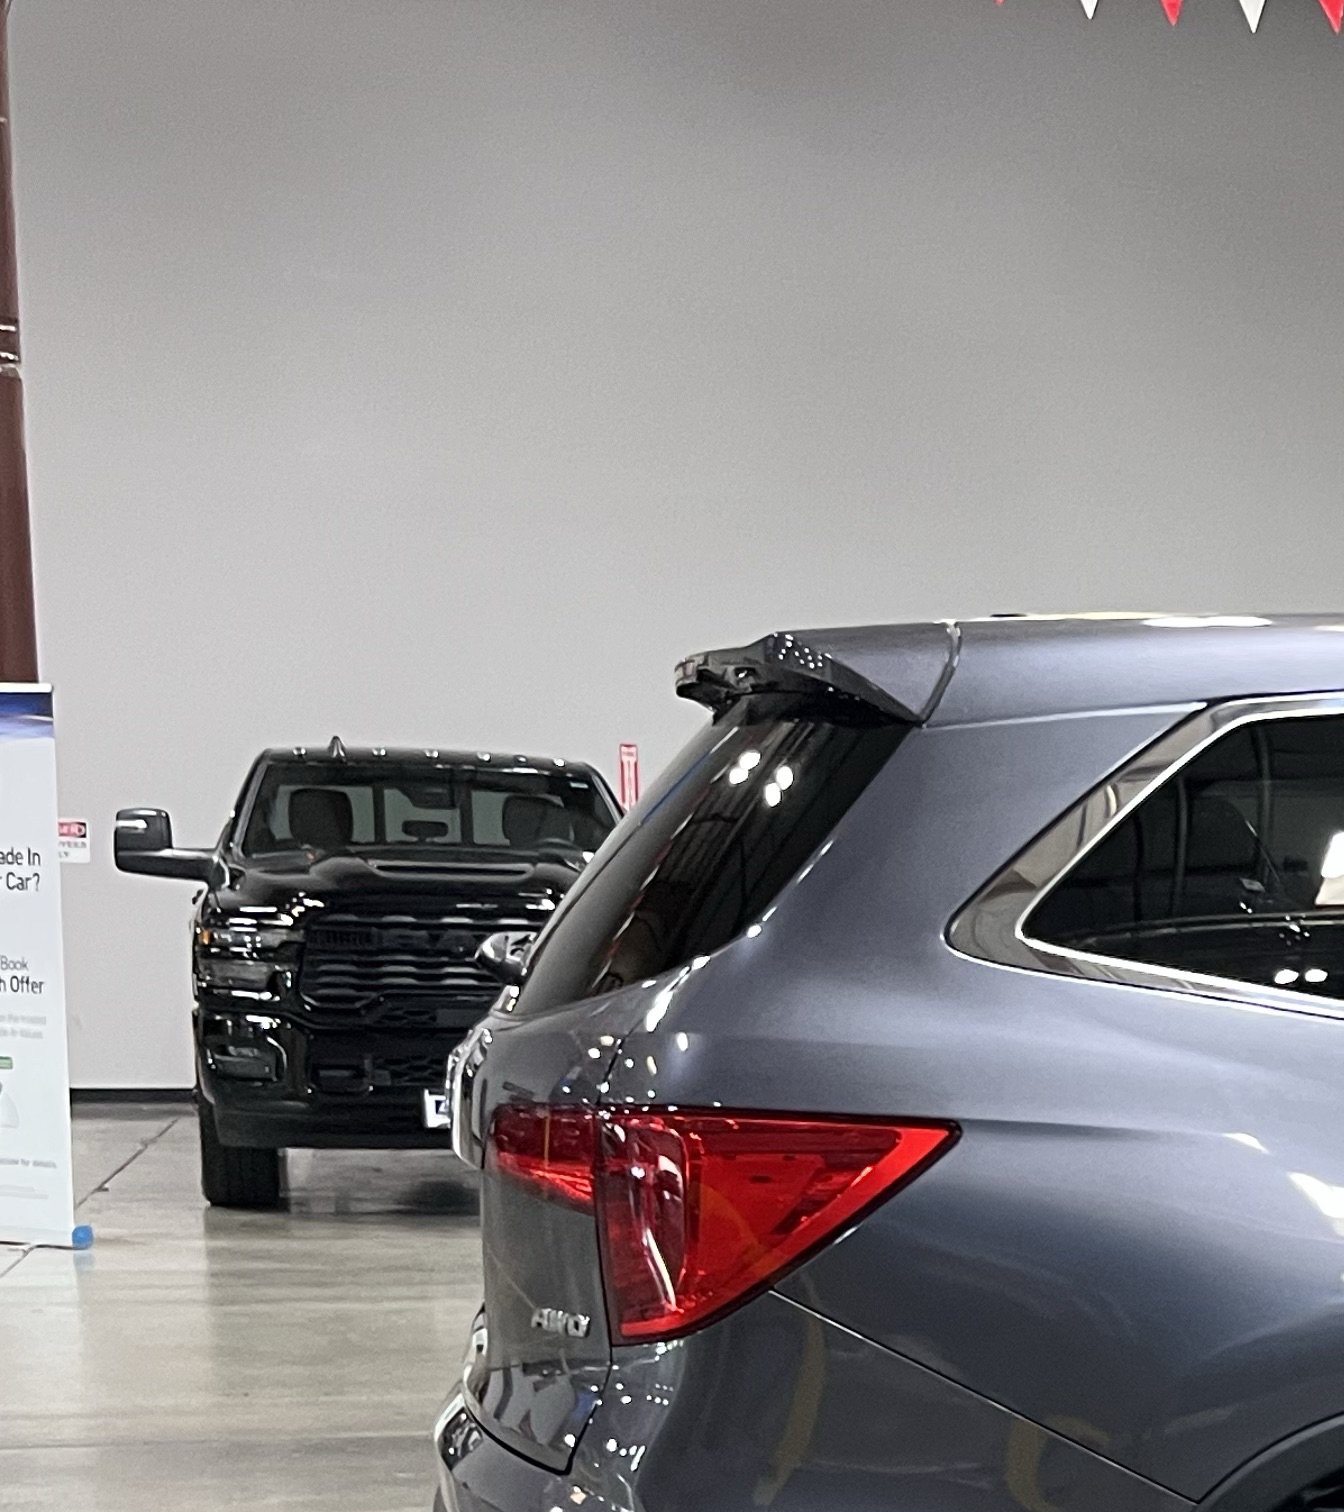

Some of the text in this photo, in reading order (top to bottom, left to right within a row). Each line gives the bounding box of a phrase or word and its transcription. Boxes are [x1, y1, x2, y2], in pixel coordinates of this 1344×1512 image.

[28, 847, 41, 866] In
[6, 871, 40, 891] Car?
[10, 975, 45, 994] Offer
